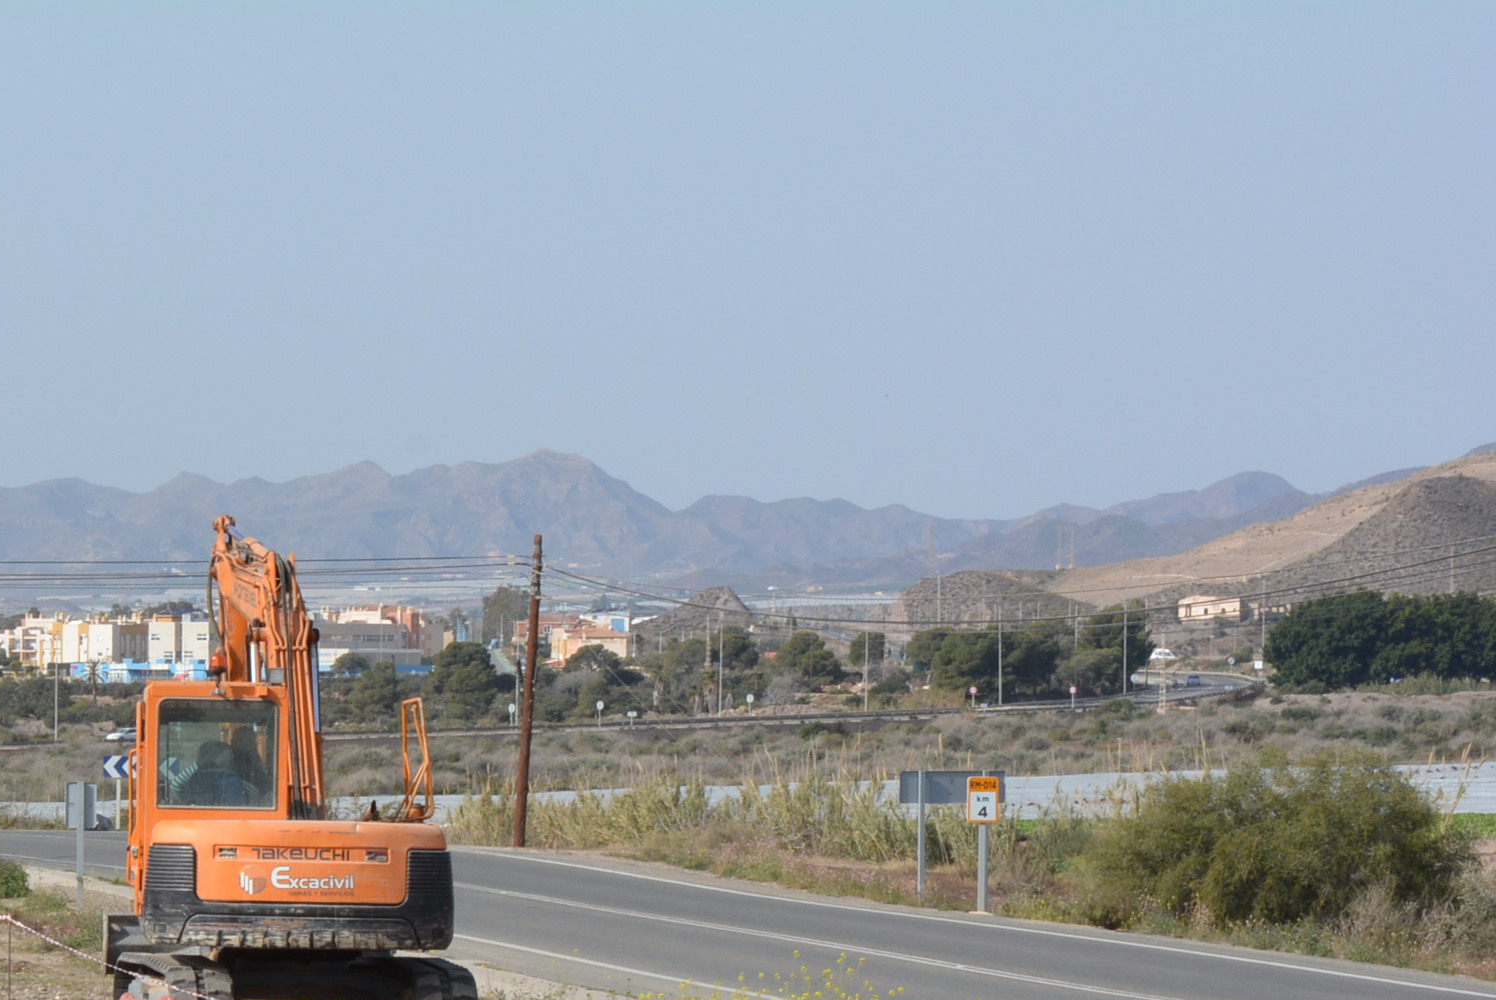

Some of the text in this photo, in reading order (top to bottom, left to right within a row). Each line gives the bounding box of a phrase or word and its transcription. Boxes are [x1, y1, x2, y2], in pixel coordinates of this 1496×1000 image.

[978, 806, 988, 817] 4
[252, 848, 350, 861] TAKEUCHI
[271, 866, 354, 889] Excacivil
